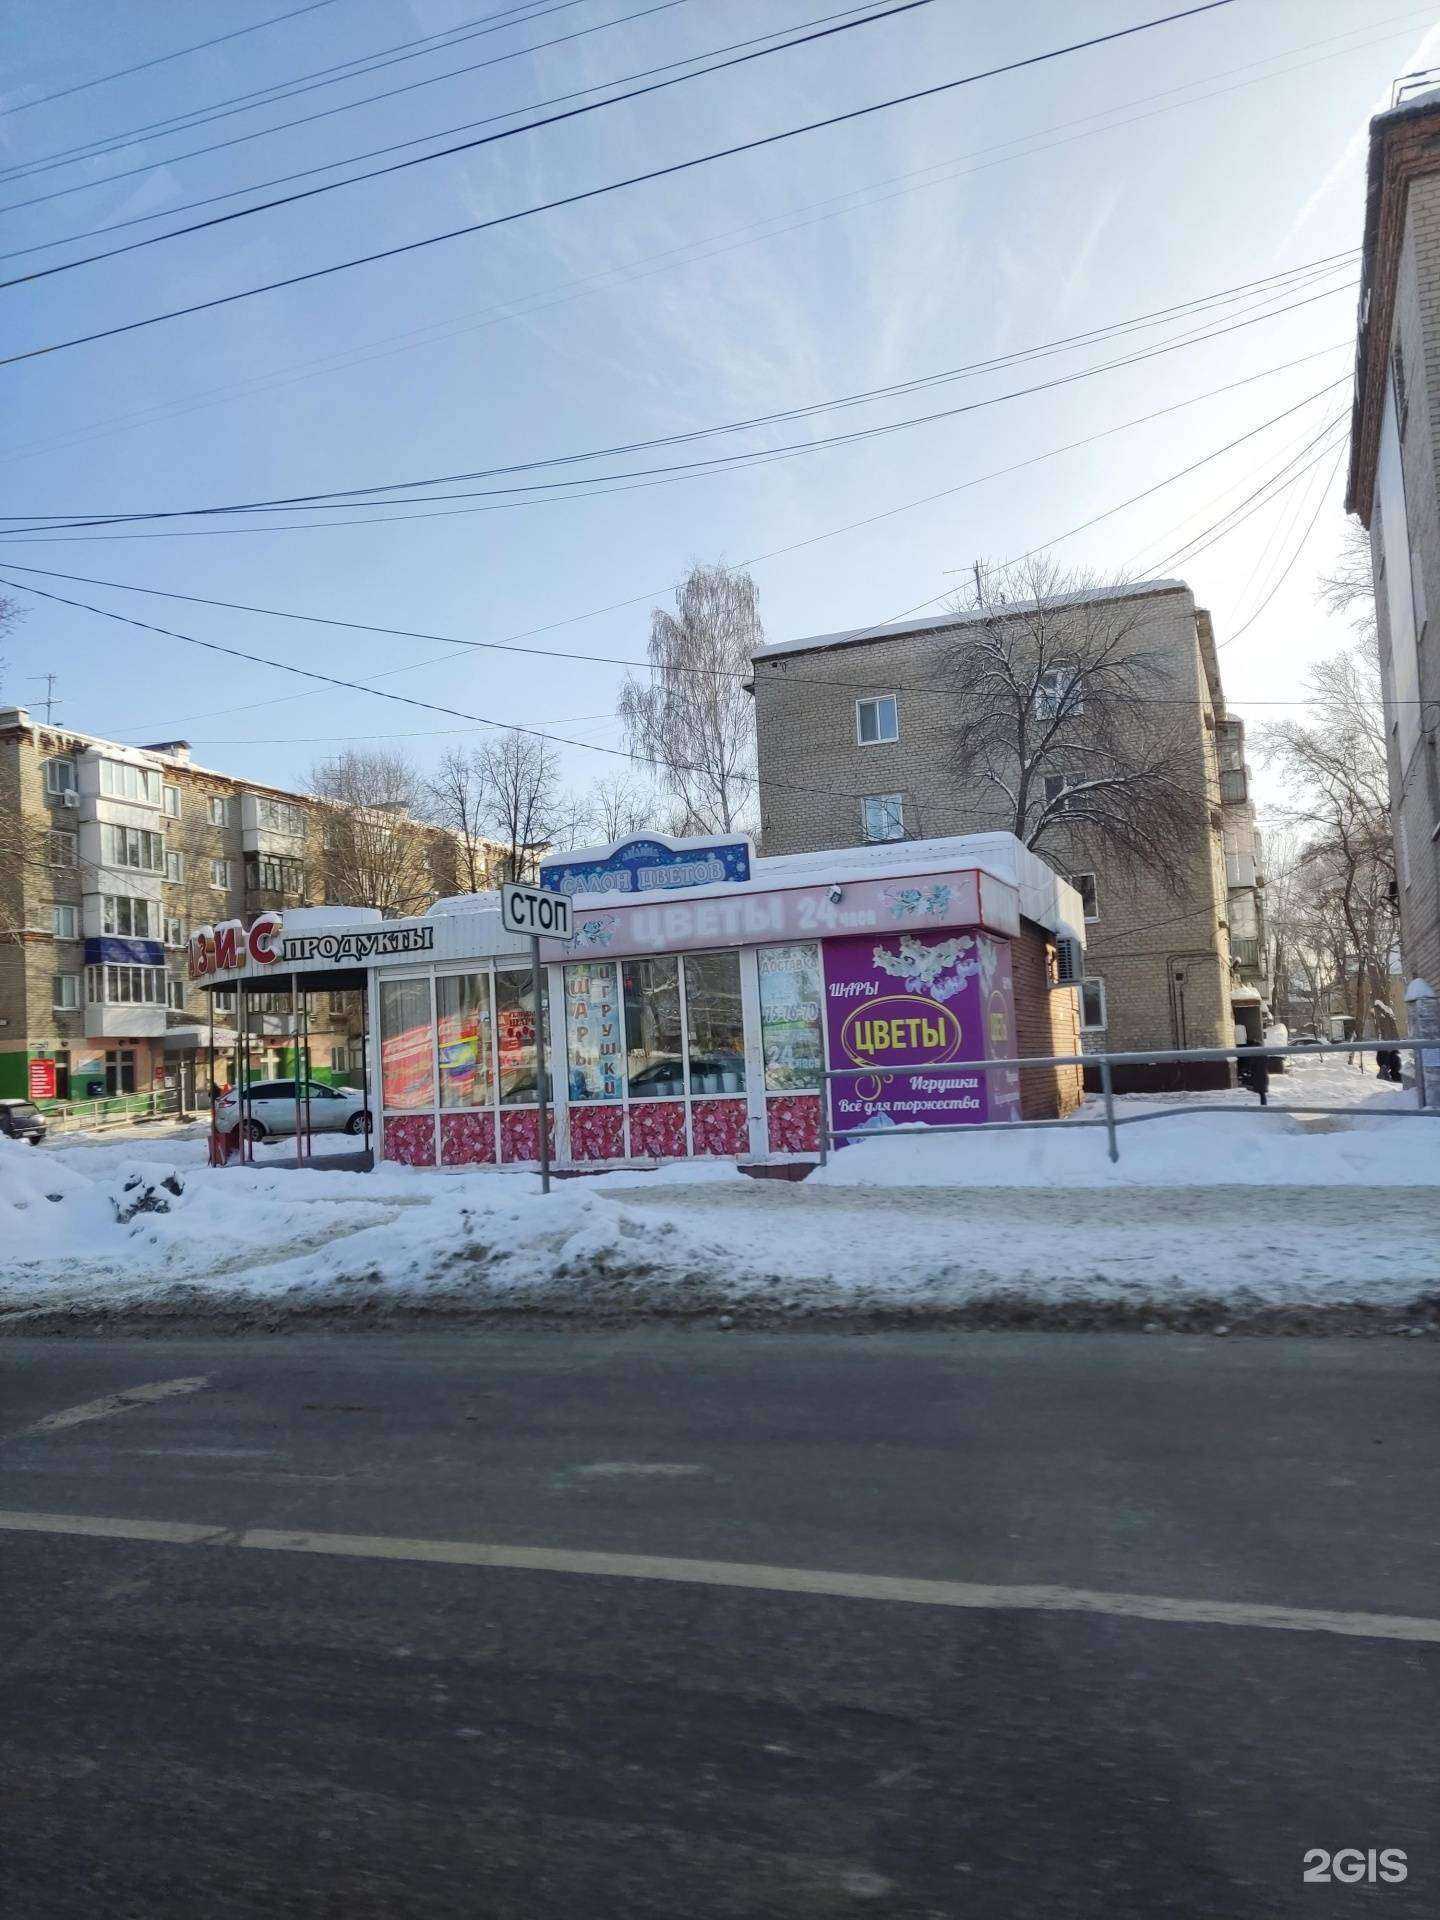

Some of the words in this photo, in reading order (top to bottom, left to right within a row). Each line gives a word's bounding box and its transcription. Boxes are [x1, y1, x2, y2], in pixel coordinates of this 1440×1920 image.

[560, 871, 632, 893] САЛОН
[637, 861, 726, 892] ЦВЕТОВ
[511, 892, 567, 932] СТОП
[631, 894, 783, 949] ЦВЕТЫ
[797, 897, 837, 931] 24
[283, 926, 433, 963] ПРОДУКТЫ
[829, 981, 879, 998] ШАРЫ
[854, 1017, 946, 1055] ЦВЕТЫ
[909, 1076, 979, 1093] Игрушки
[838, 1099, 863, 1113] Всё
[864, 1101, 891, 1115] для
[893, 1096, 980, 1114] торжества
